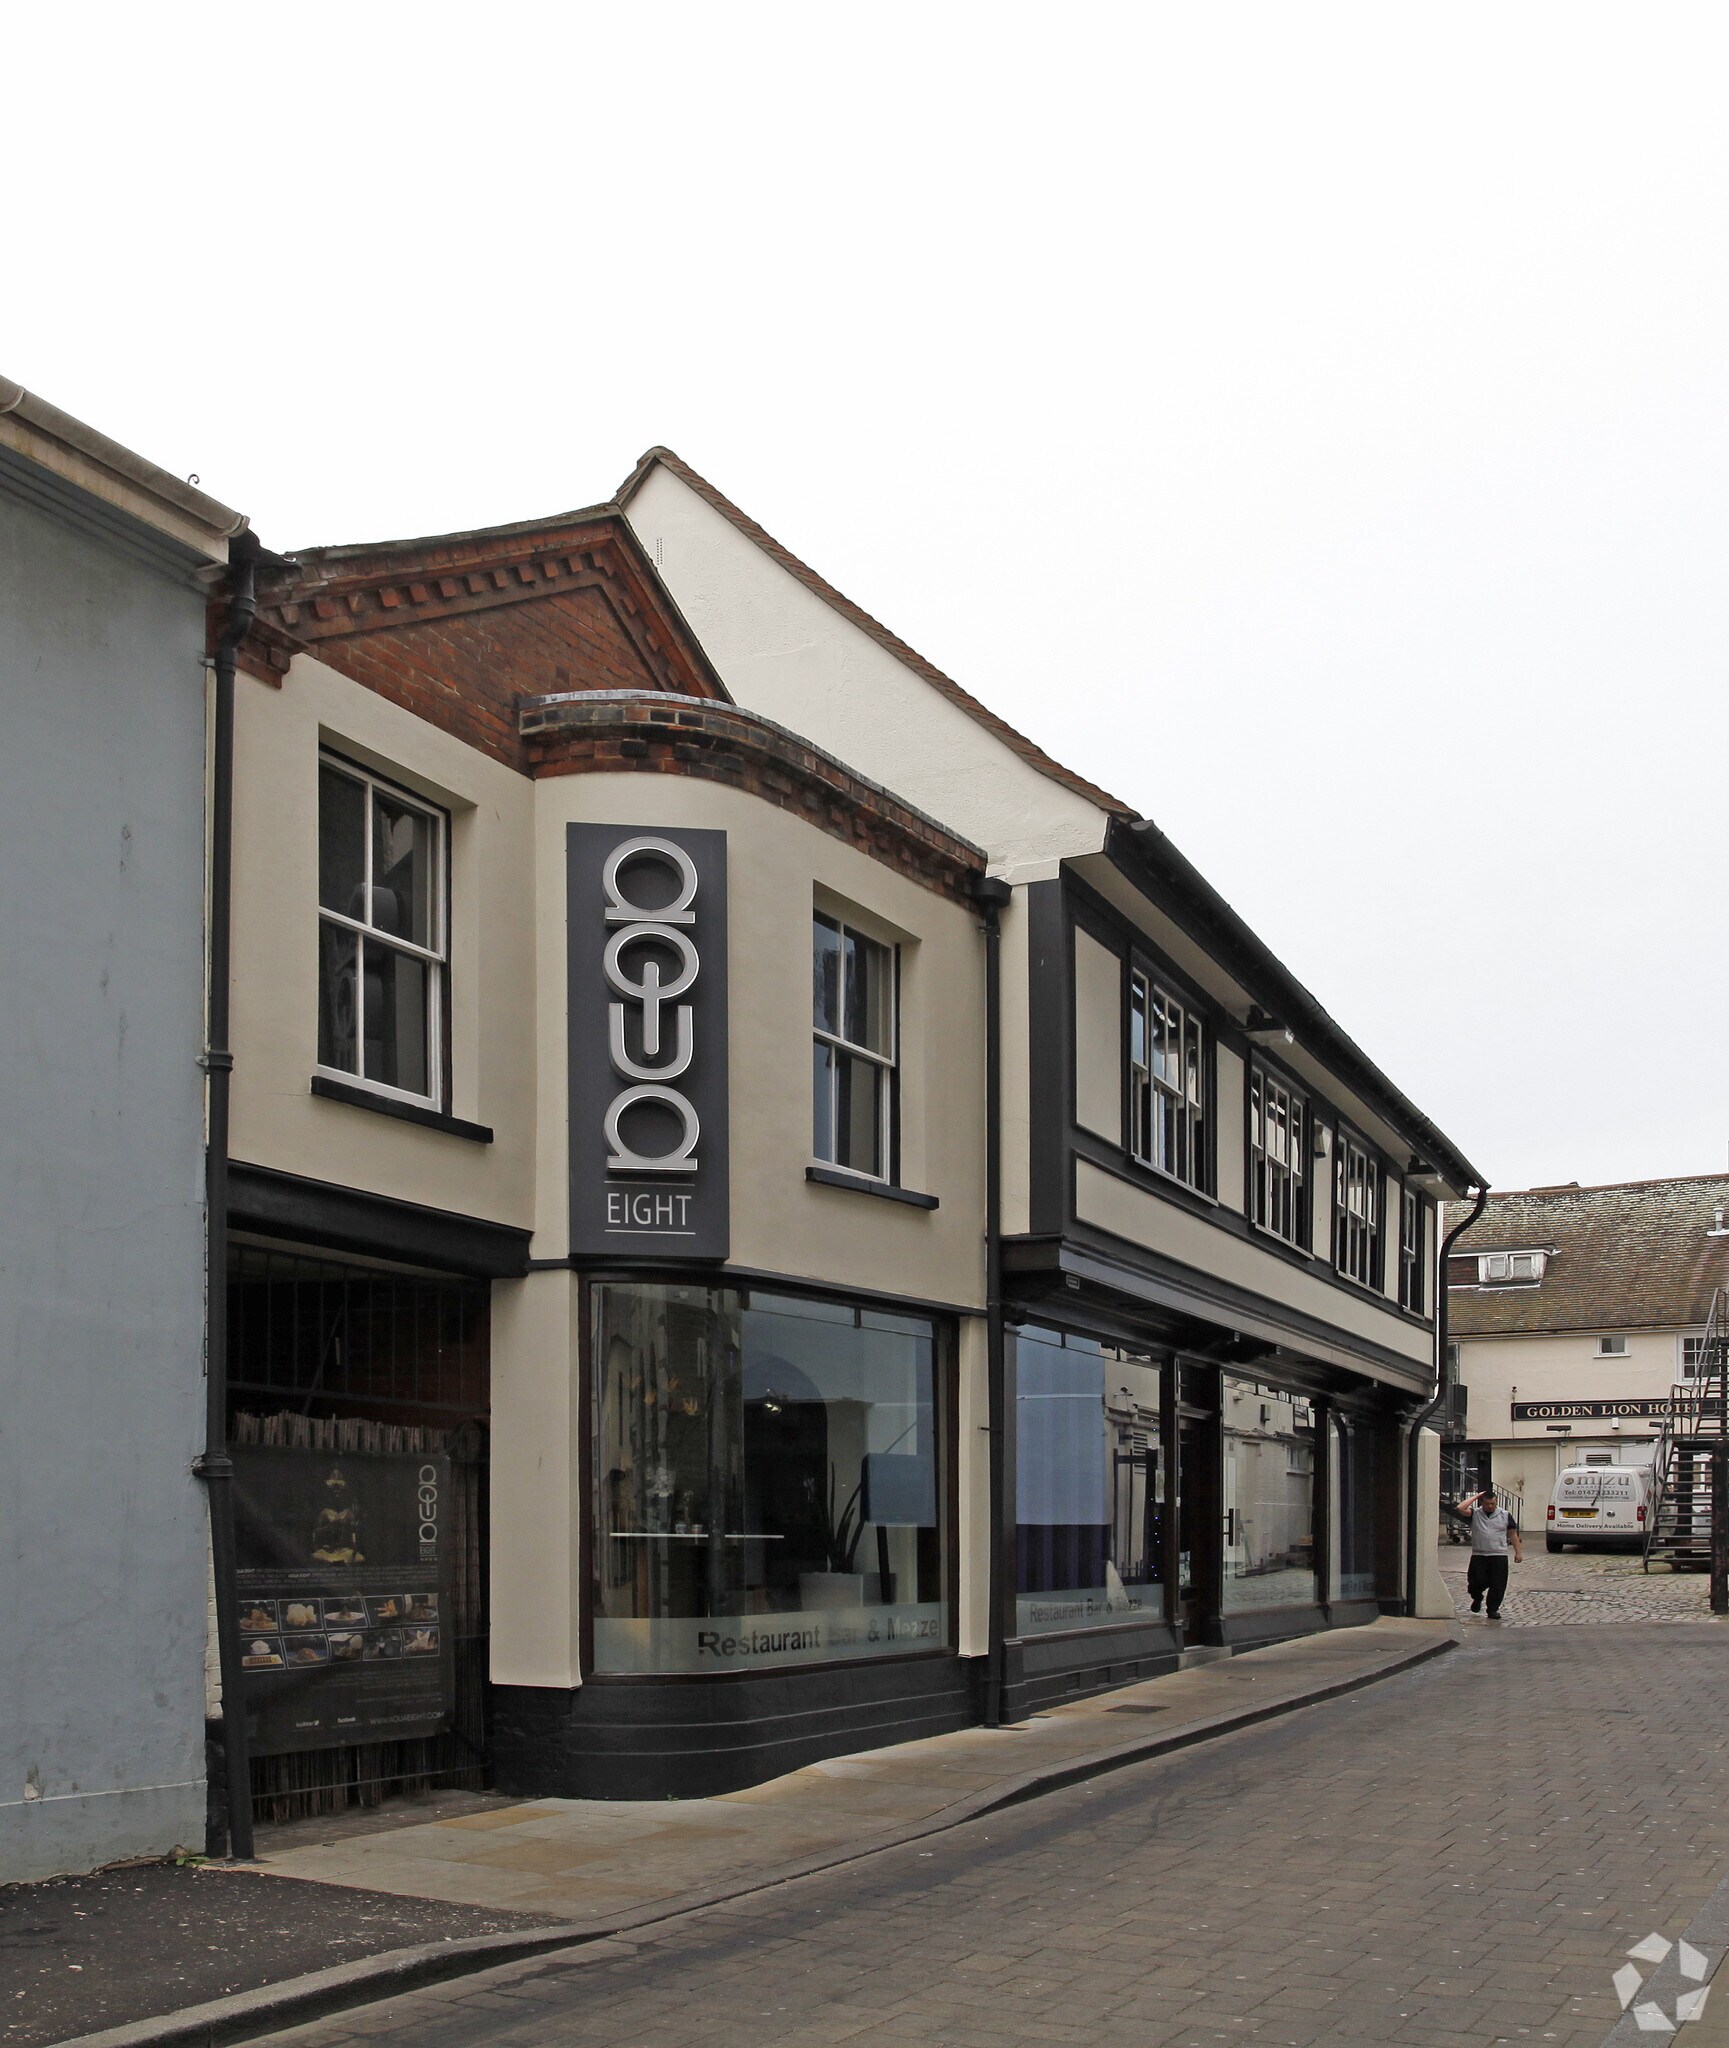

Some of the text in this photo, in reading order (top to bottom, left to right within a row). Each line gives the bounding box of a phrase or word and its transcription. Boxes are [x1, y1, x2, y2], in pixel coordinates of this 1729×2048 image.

[607, 1192, 693, 1226] EIGHT
[1526, 1405, 1593, 1418] GOLDEN
[1601, 1403, 1642, 1416] LION
[1029, 1600, 1084, 1624] Restaurant
[1086, 1599, 1102, 1617] Bar
[697, 1625, 821, 1657] Restaurant
[866, 1618, 880, 1643] &
